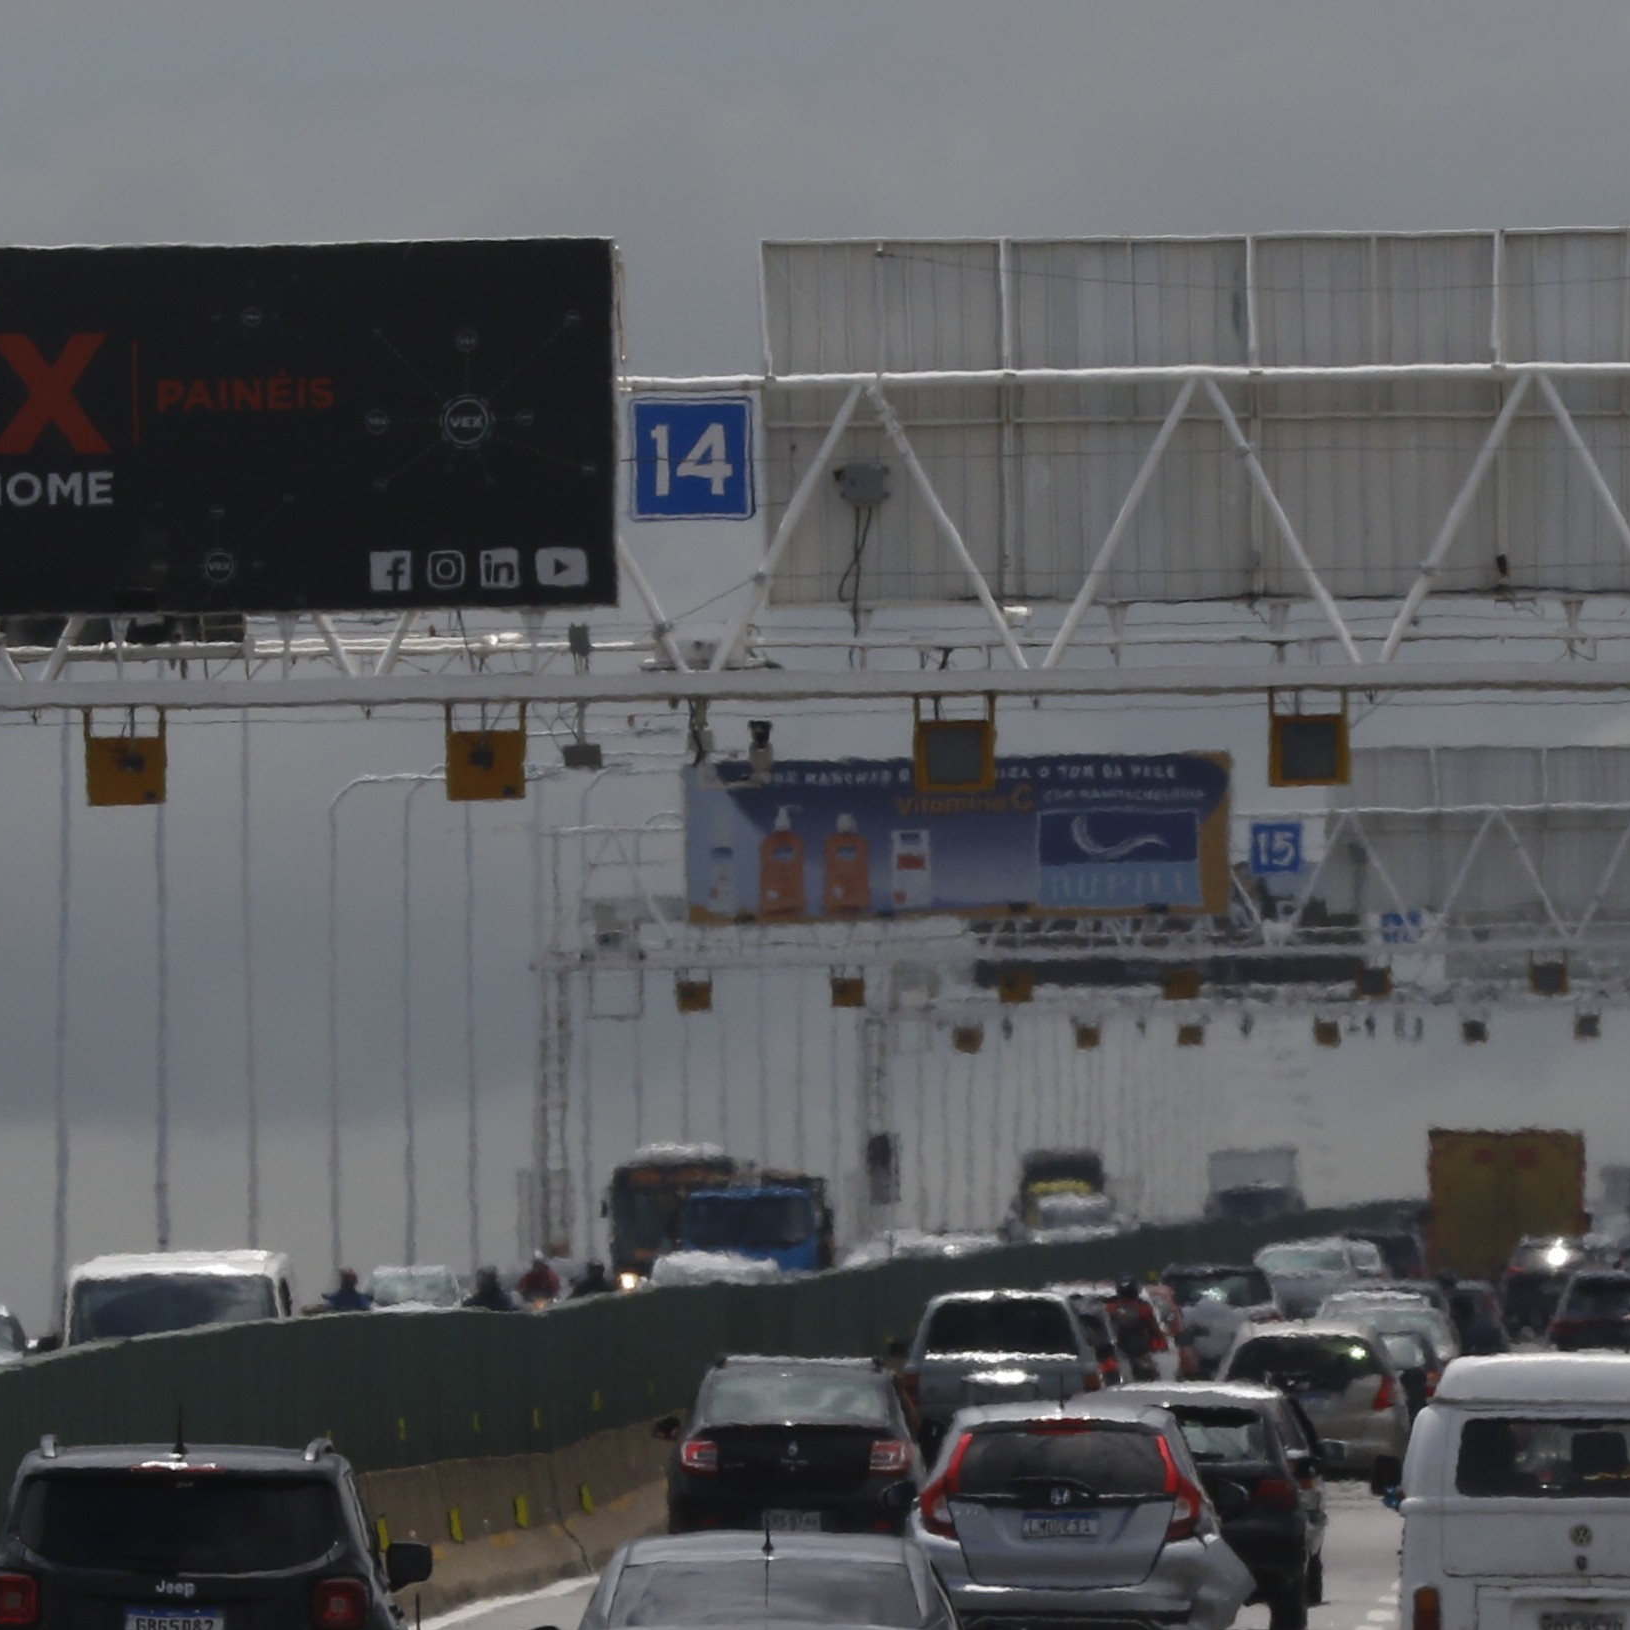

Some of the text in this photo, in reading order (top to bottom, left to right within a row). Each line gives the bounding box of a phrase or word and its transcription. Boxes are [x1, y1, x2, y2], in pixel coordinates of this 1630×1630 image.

[157, 369, 337, 414] PAINÉIS
[652, 423, 732, 496] 14
[1256, 832, 1295, 865] 15
[155, 1579, 197, 1598] Jeep
